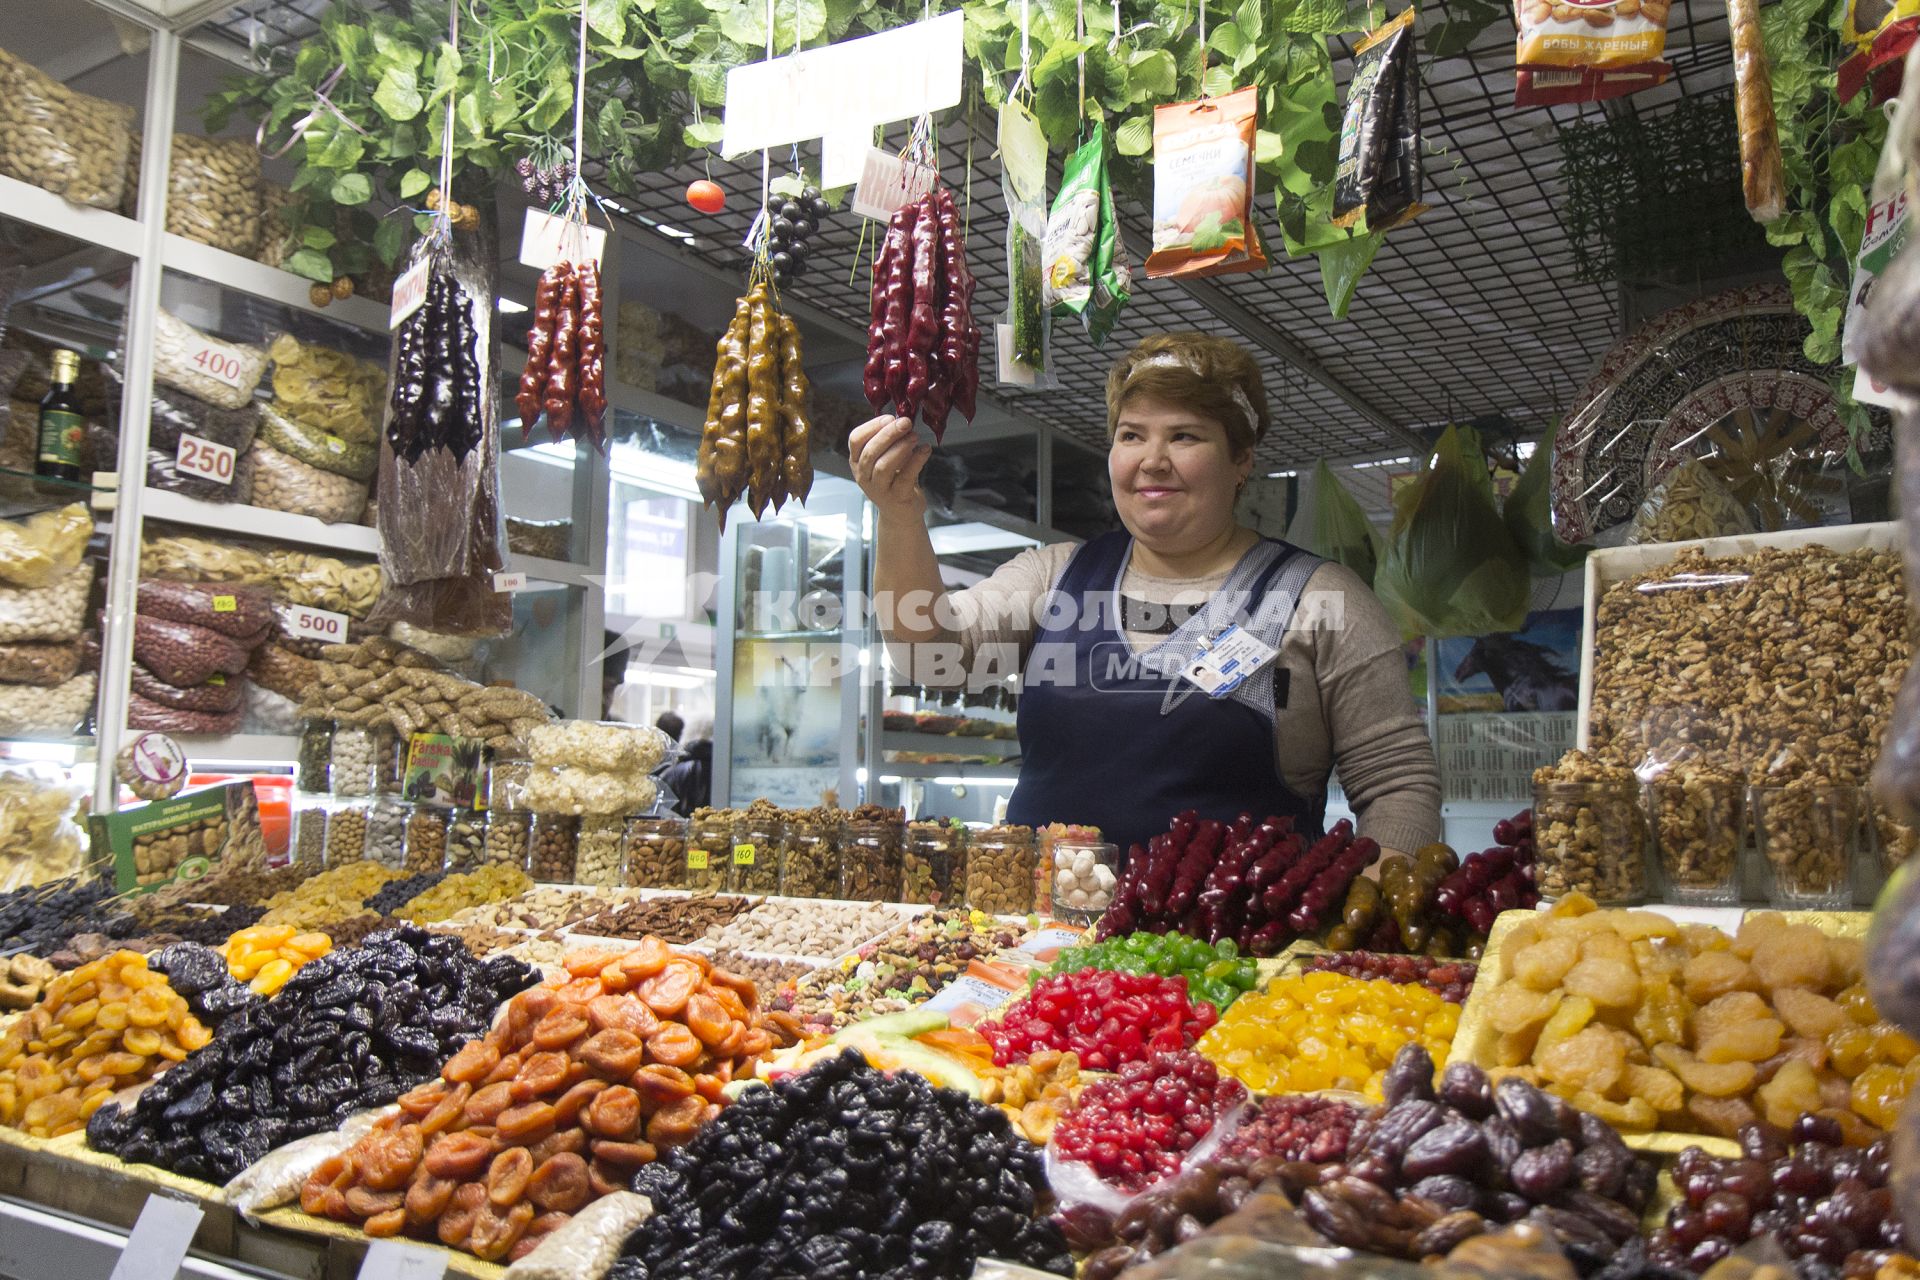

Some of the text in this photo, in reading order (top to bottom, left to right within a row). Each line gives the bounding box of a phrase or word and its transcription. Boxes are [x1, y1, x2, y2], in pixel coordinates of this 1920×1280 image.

[1542, 38, 1650, 51] БОБЫ ЖАРЕНЫЕ
[1169, 149, 1222, 170] СЕМЕЧКИ
[193, 350, 240, 380] 400
[180, 440, 232, 478] 250
[300, 614, 338, 634] 500
